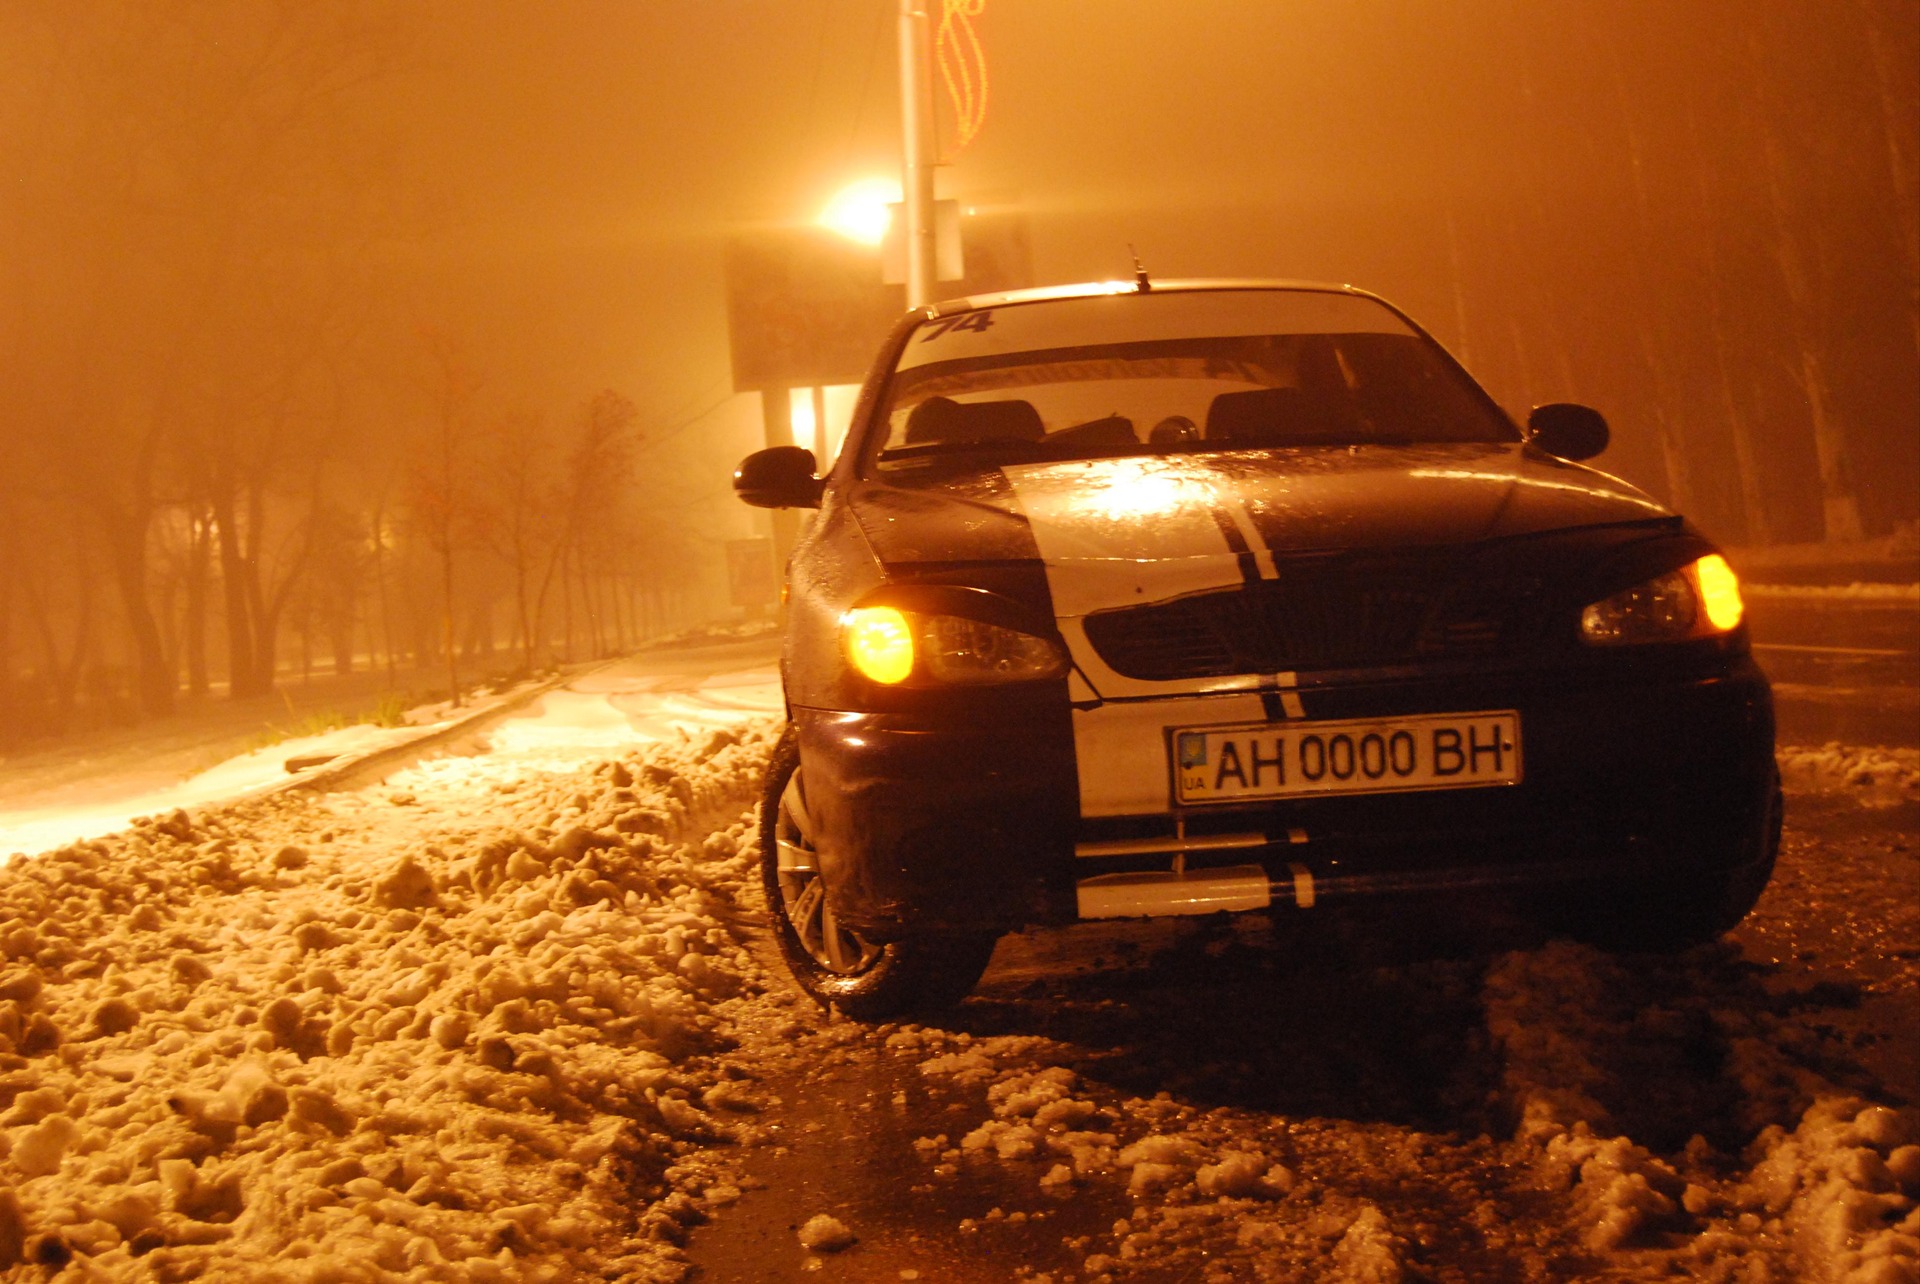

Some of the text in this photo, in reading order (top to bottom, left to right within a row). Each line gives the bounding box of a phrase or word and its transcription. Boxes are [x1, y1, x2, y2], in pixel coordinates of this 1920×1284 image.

[919, 311, 996, 344] 74
[1214, 724, 1504, 790] AH 0000 BH
[1183, 777, 1206, 791] UA
